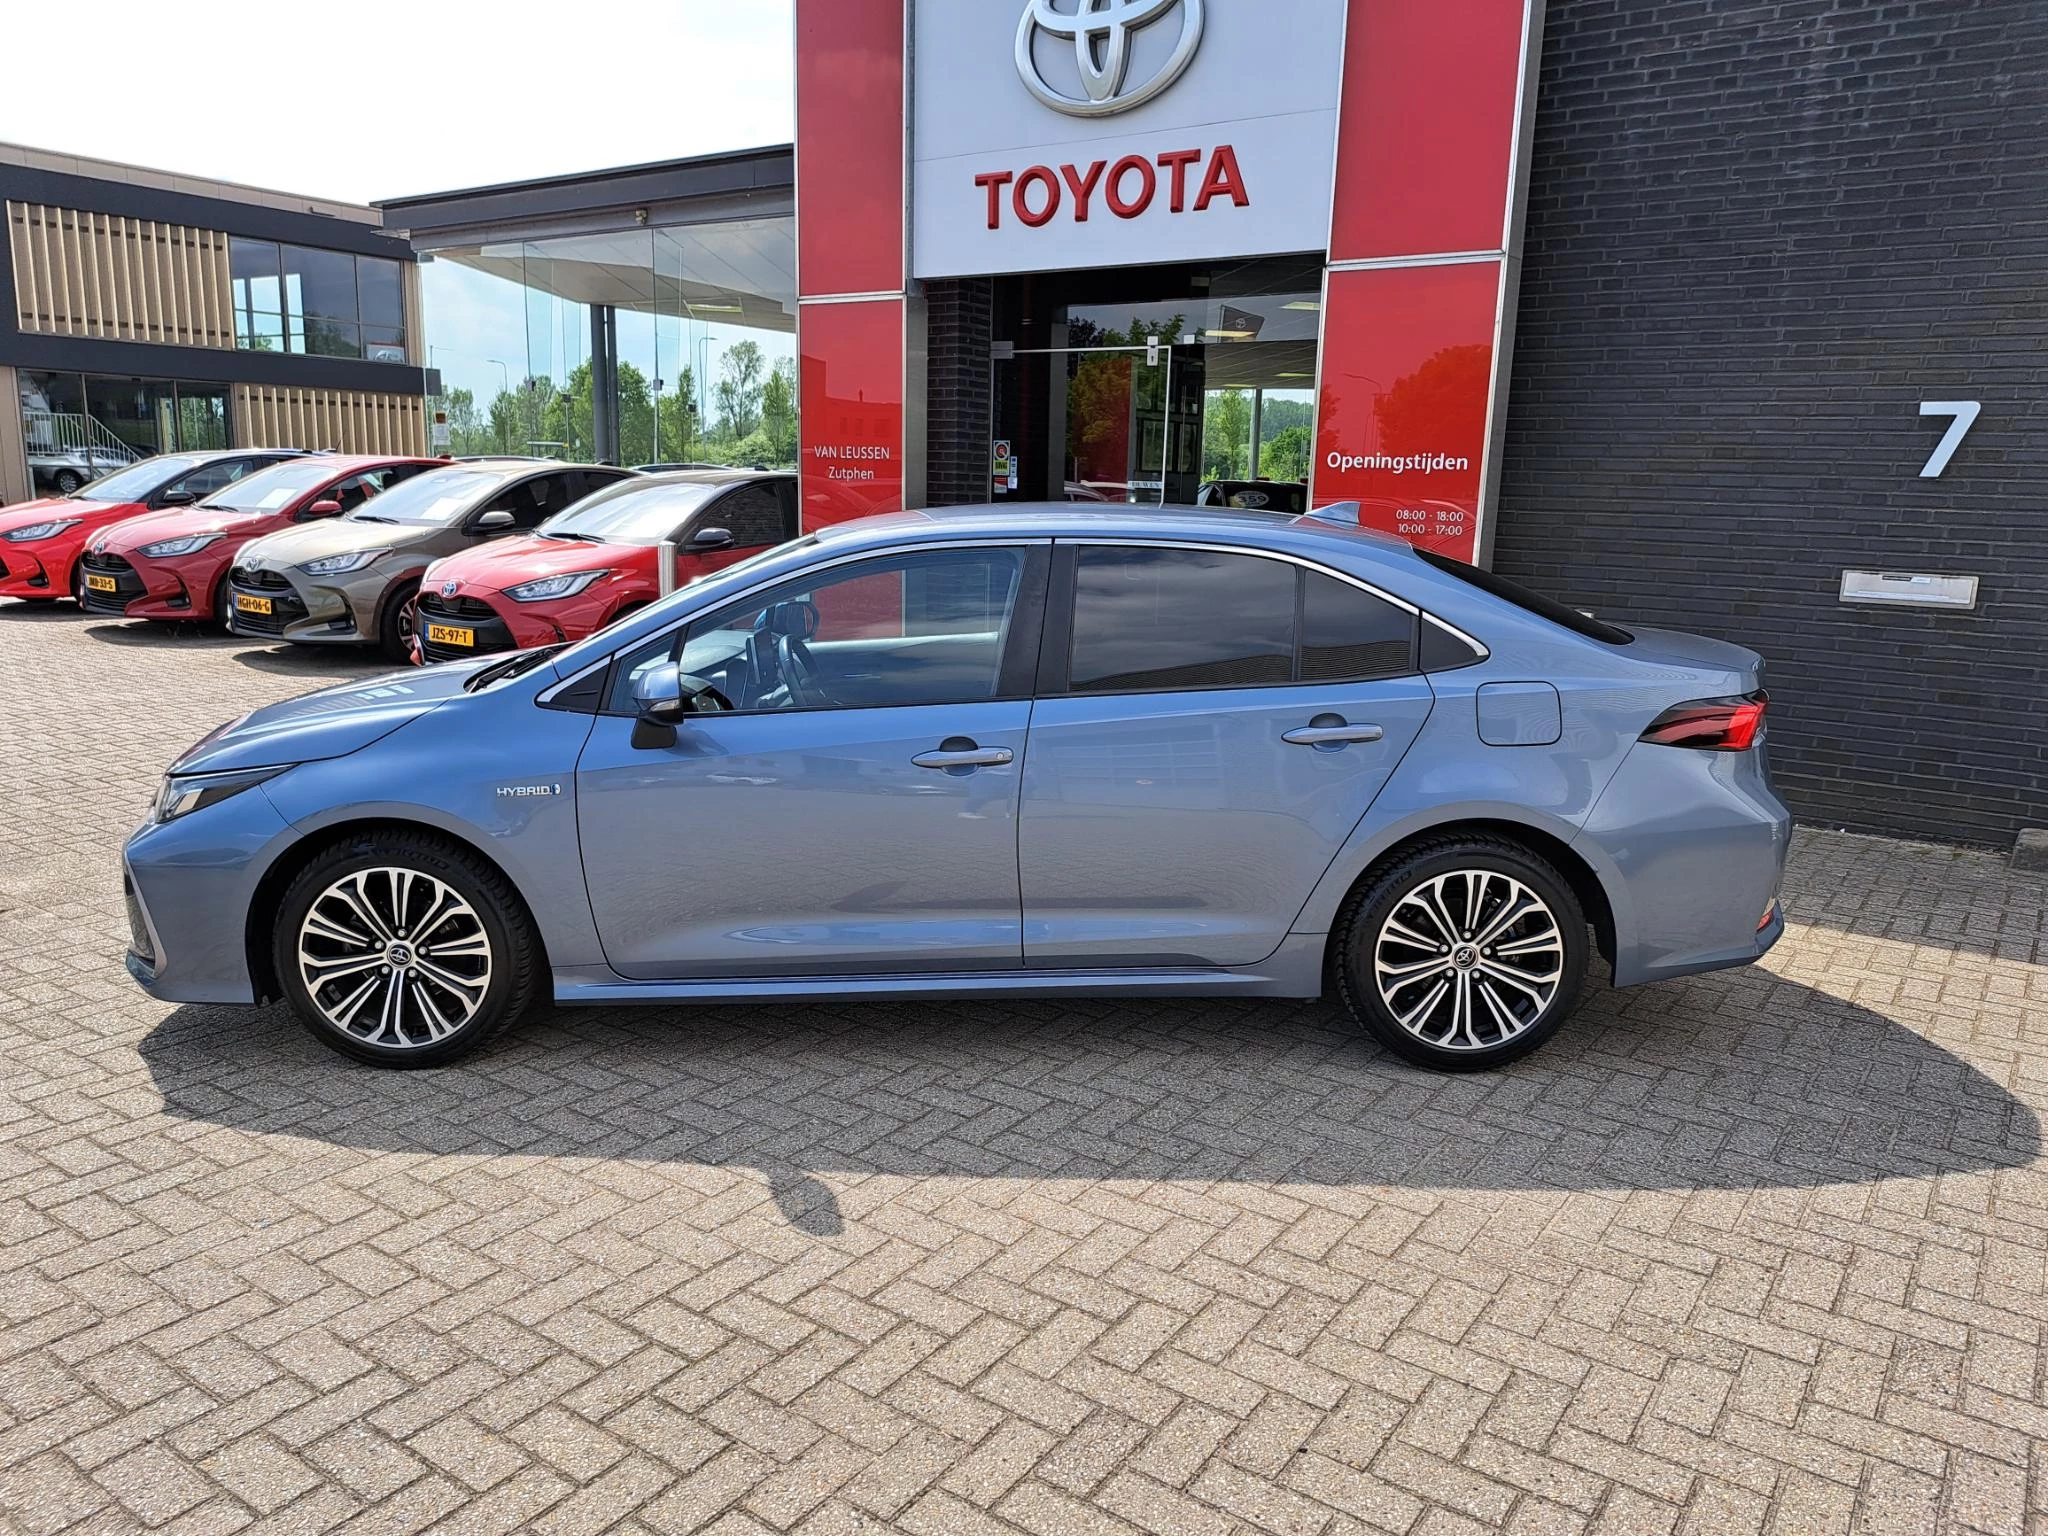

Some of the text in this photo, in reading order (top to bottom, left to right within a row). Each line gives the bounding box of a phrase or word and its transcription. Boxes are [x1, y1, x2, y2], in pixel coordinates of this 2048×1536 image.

[975, 145, 1249, 229] TOYOTA
[1919, 401, 1981, 478] 7
[814, 446, 890, 459] VAN LEUSSEN
[1327, 451, 1468, 474] Openingstijden
[828, 466, 874, 481] Zutphen
[1396, 510, 1426, 521] 08:00
[1436, 511, 1464, 522] 18:00
[1398, 524, 1425, 534] 10:00
[1436, 525, 1463, 536] 17:00
[237, 596, 271, 612] HGH-06-G
[431, 627, 468, 644] JZS-97-T
[496, 785, 552, 797] HYBRID
